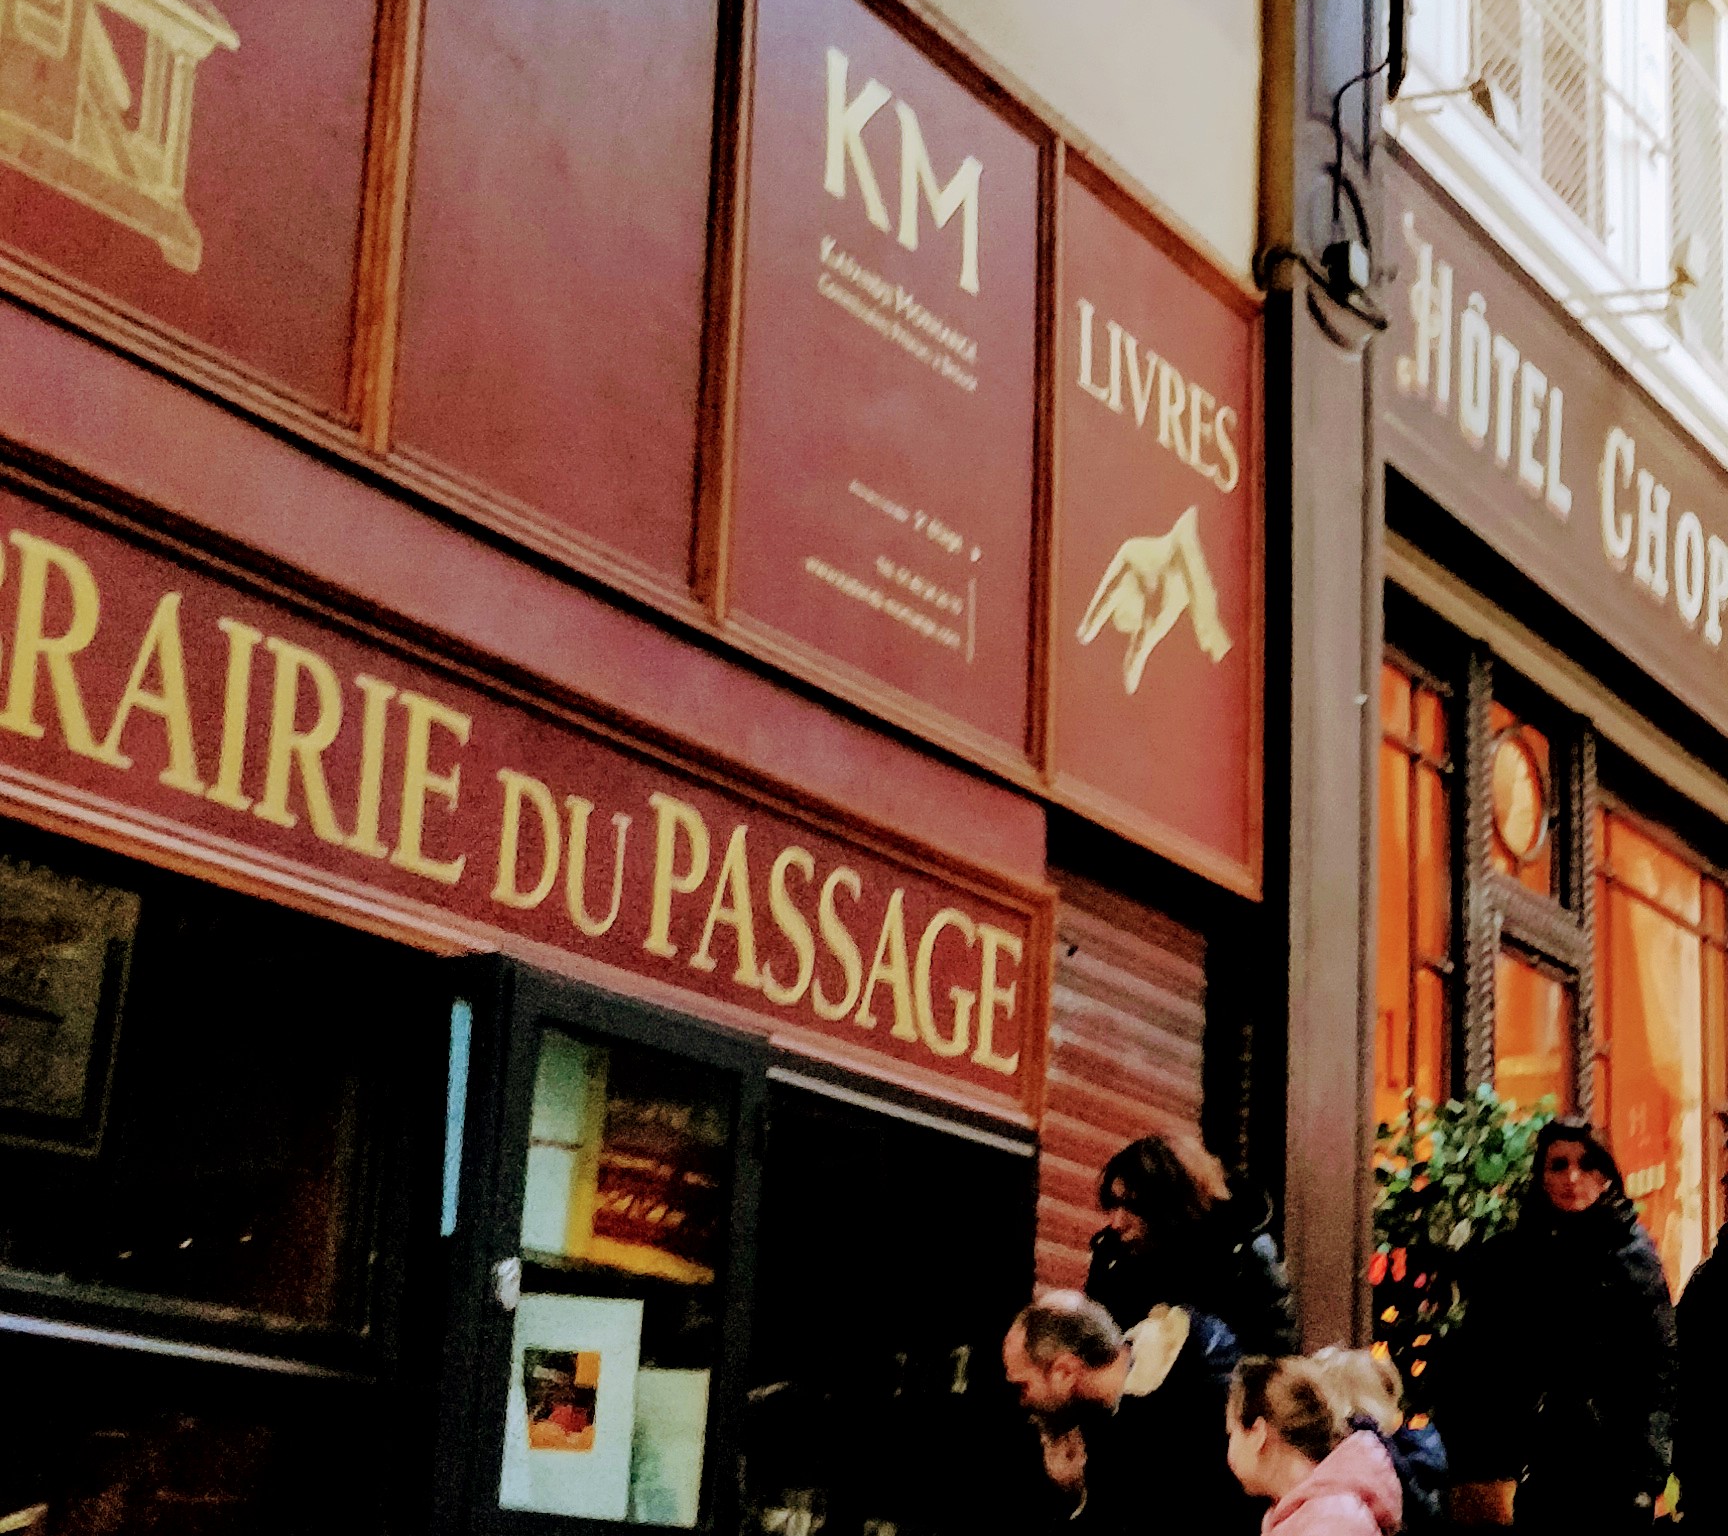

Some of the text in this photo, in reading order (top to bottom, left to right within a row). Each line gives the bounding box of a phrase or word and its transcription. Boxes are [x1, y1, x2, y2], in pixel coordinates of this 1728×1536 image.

[823, 46, 983, 294] KM
[1077, 298, 1240, 493] LIVRES
[1397, 212, 1572, 520] HÔTEL
[0, 528, 1024, 1076] RAIRIE DU PASSAGE
